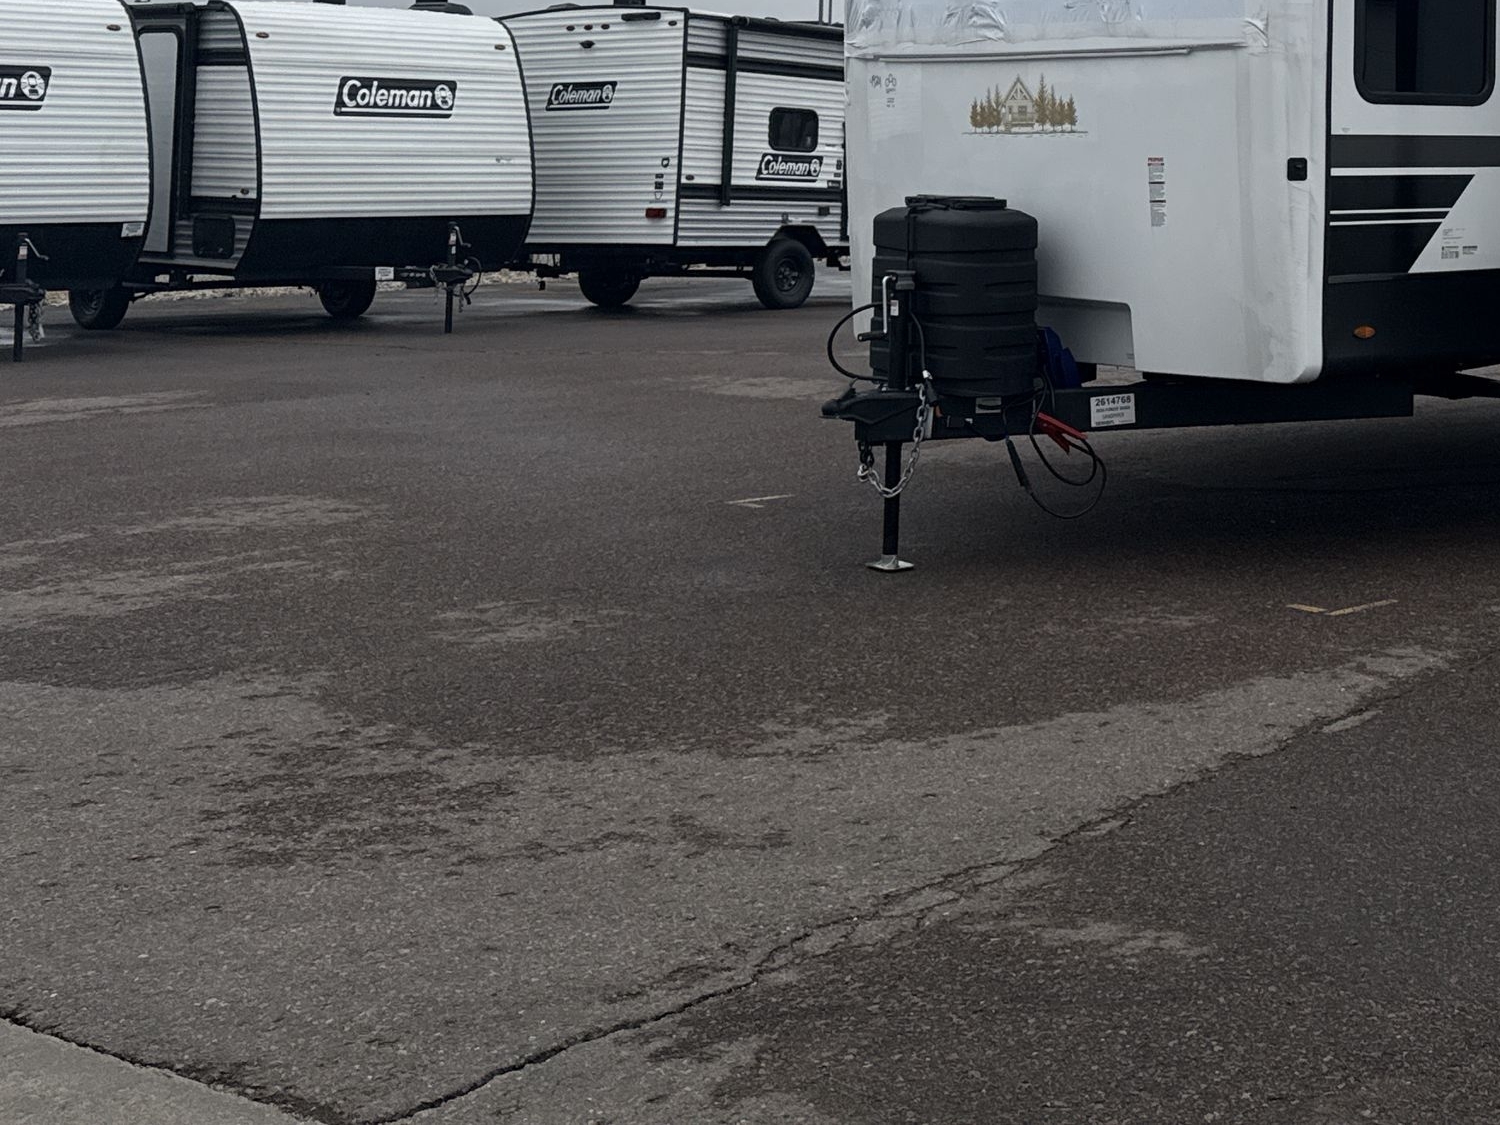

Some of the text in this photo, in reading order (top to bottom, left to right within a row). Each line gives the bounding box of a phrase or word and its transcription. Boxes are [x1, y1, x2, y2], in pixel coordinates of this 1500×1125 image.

[342, 79, 433, 108] Coleman
[551, 84, 602, 105] Coleman
[761, 155, 810, 175] Coleman
[1095, 395, 1131, 406] 2614768
